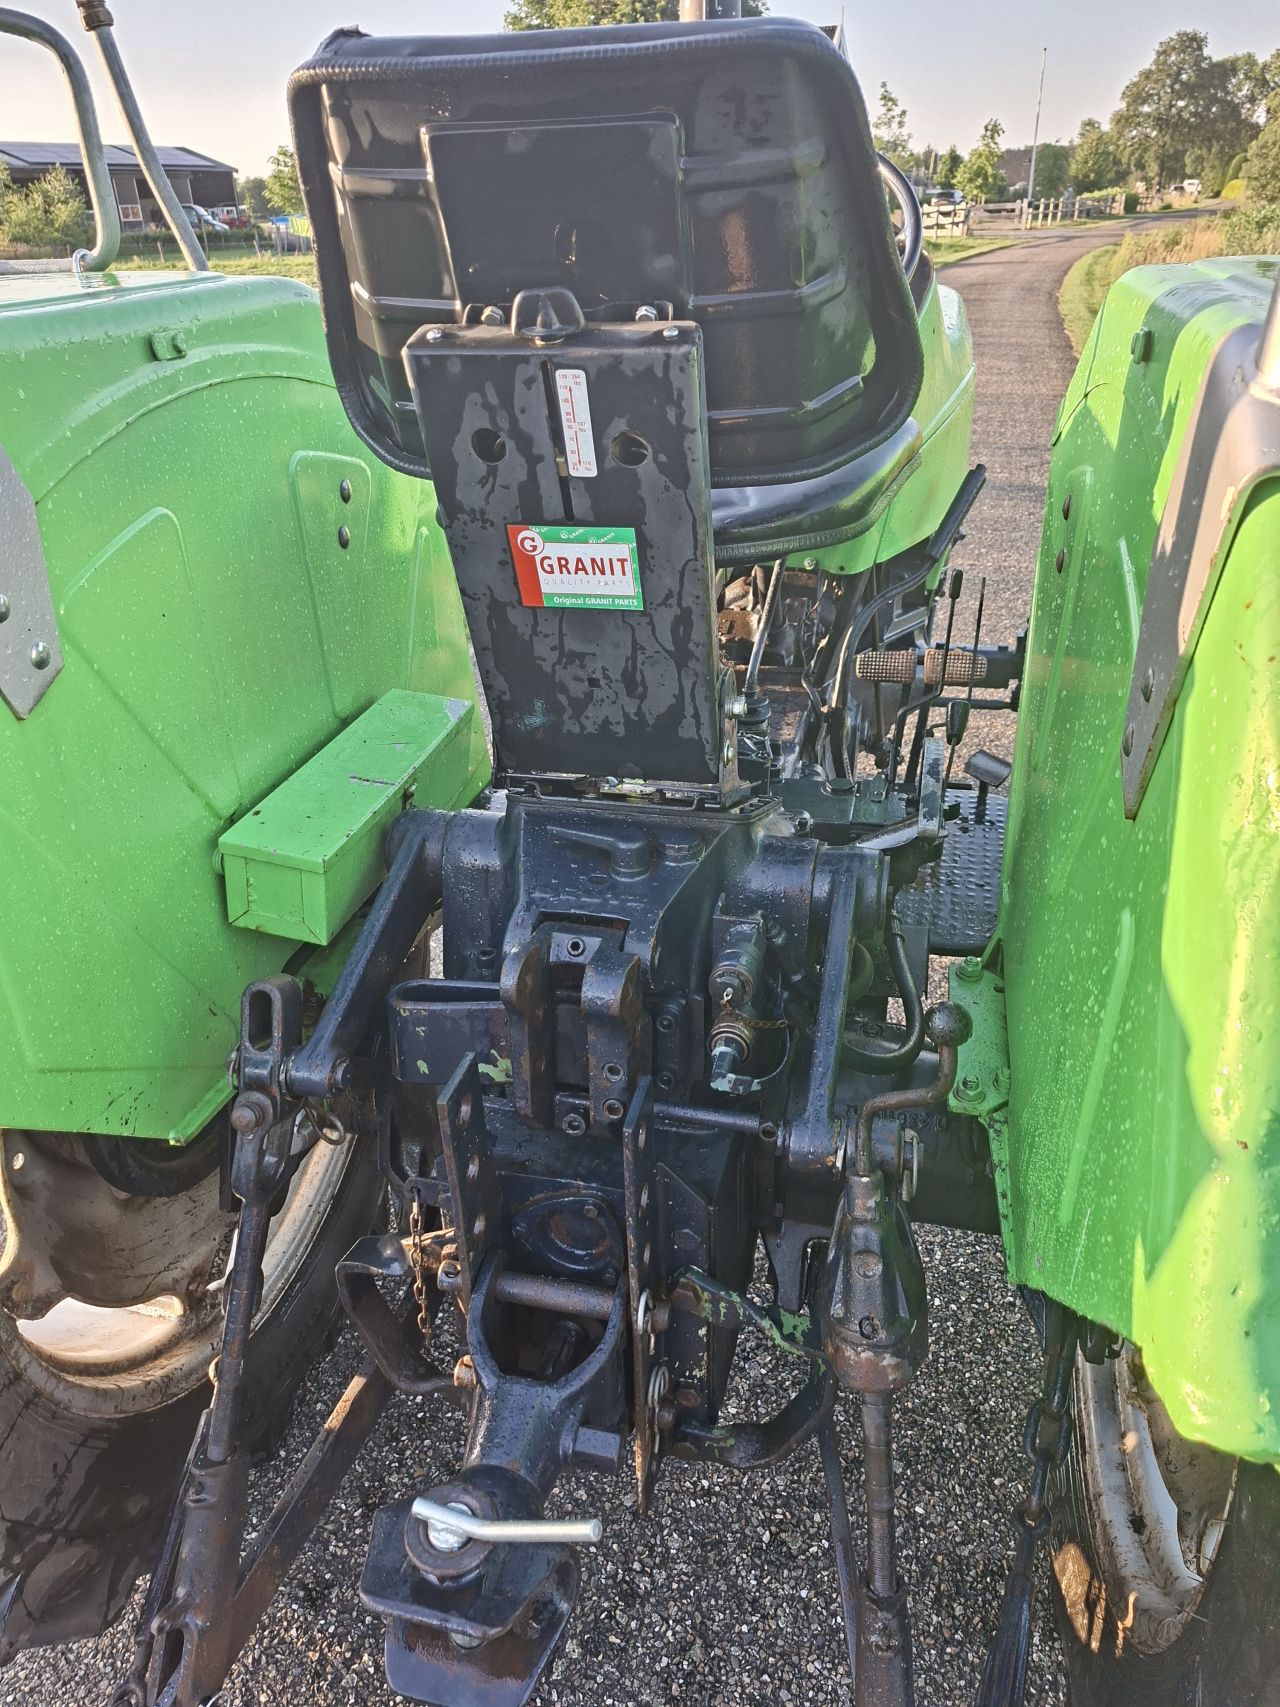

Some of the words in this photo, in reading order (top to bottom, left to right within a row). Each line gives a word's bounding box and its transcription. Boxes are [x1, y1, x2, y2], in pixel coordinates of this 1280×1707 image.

[519, 536, 538, 553] G
[539, 555, 629, 577] GRANIT
[544, 578, 591, 586] QUALITY
[597, 579, 630, 587] PARTS
[553, 596, 584, 606] Original
[585, 597, 613, 605] GRANIT
[614, 598, 638, 606] PARTS
